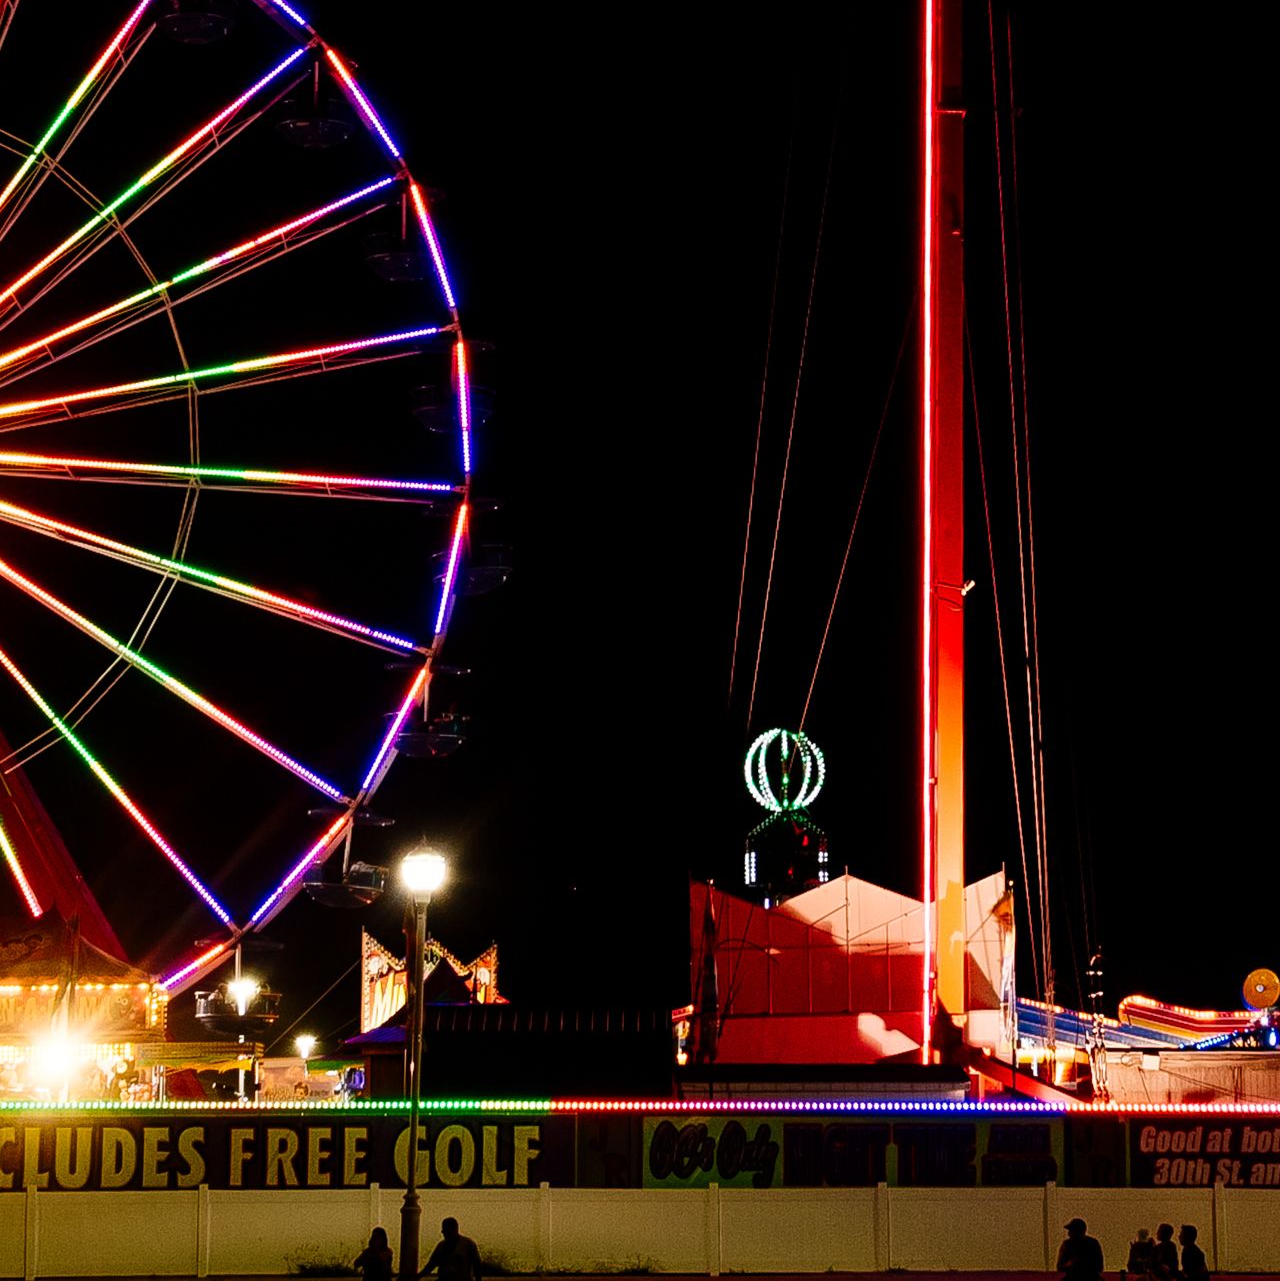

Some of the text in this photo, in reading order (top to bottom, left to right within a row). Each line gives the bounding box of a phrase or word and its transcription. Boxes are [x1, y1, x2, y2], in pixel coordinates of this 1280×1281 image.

[1139, 1125, 1202, 1154] Good
[1206, 1130, 1232, 1153] at
[228, 1126, 367, 1187] FREE
[391, 1124, 542, 1188] GOLF
[1152, 1159, 1210, 1186] 30th
[1216, 1159, 1244, 1185] St.
